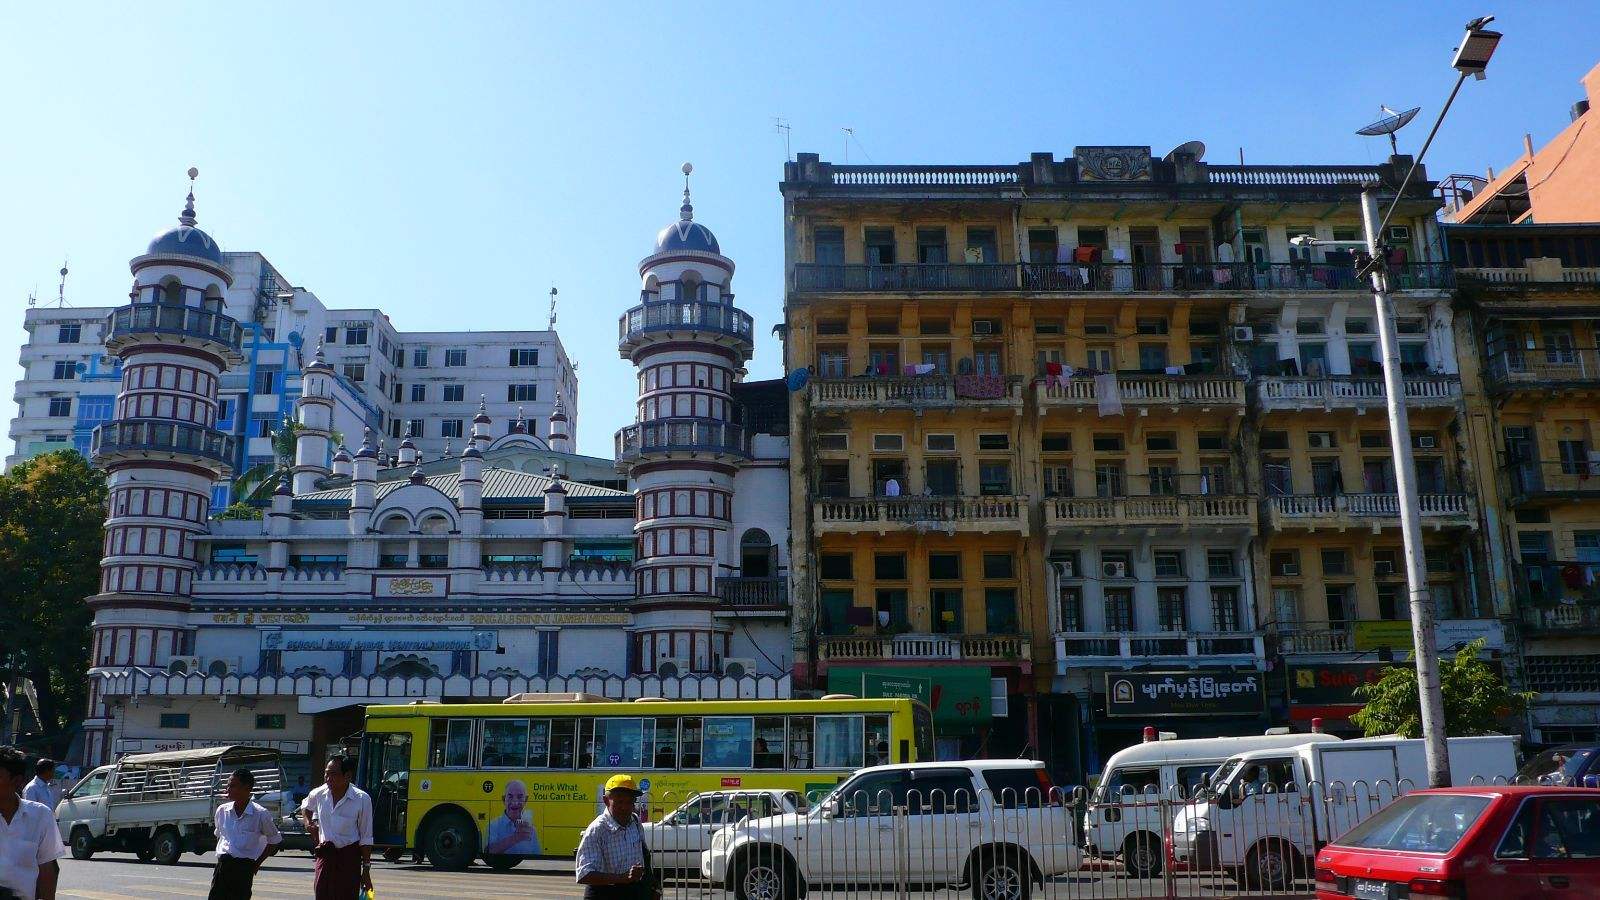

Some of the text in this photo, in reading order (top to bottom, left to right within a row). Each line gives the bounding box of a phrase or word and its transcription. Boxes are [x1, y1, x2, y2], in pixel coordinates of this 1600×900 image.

[533, 783, 578, 791] Drink What
[533, 793, 588, 801] You Can't Eat.
